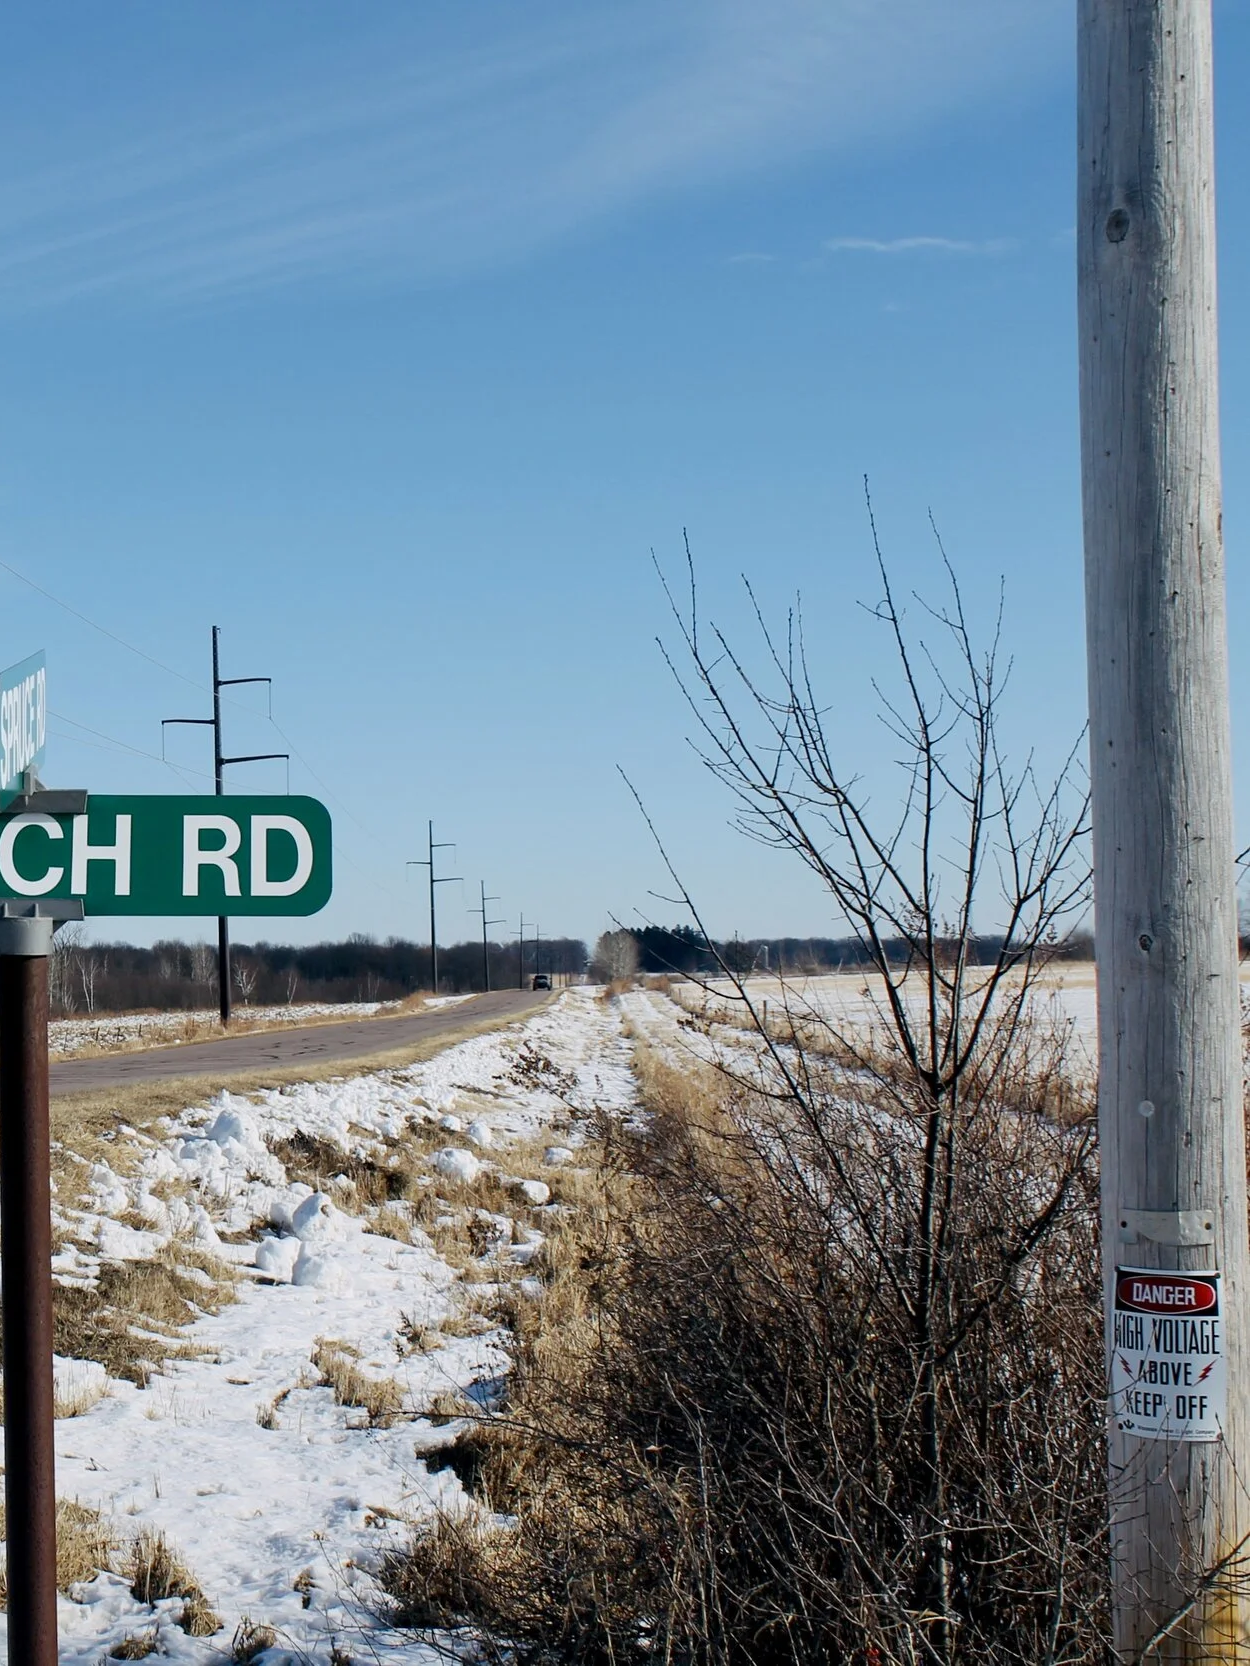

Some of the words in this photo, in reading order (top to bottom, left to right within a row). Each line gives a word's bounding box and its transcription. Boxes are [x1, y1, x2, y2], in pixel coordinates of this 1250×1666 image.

[0, 674, 35, 789] SPRUCE
[182, 814, 315, 898] RD
[1132, 1282, 1197, 1306] DANGER
[1114, 1312, 1144, 1351] HIGH
[1152, 1318, 1220, 1355] VOLTAGE
[1139, 1359, 1193, 1387] ABOVE
[1126, 1389, 1163, 1418] KEEP
[1176, 1395, 1208, 1420] OFF
